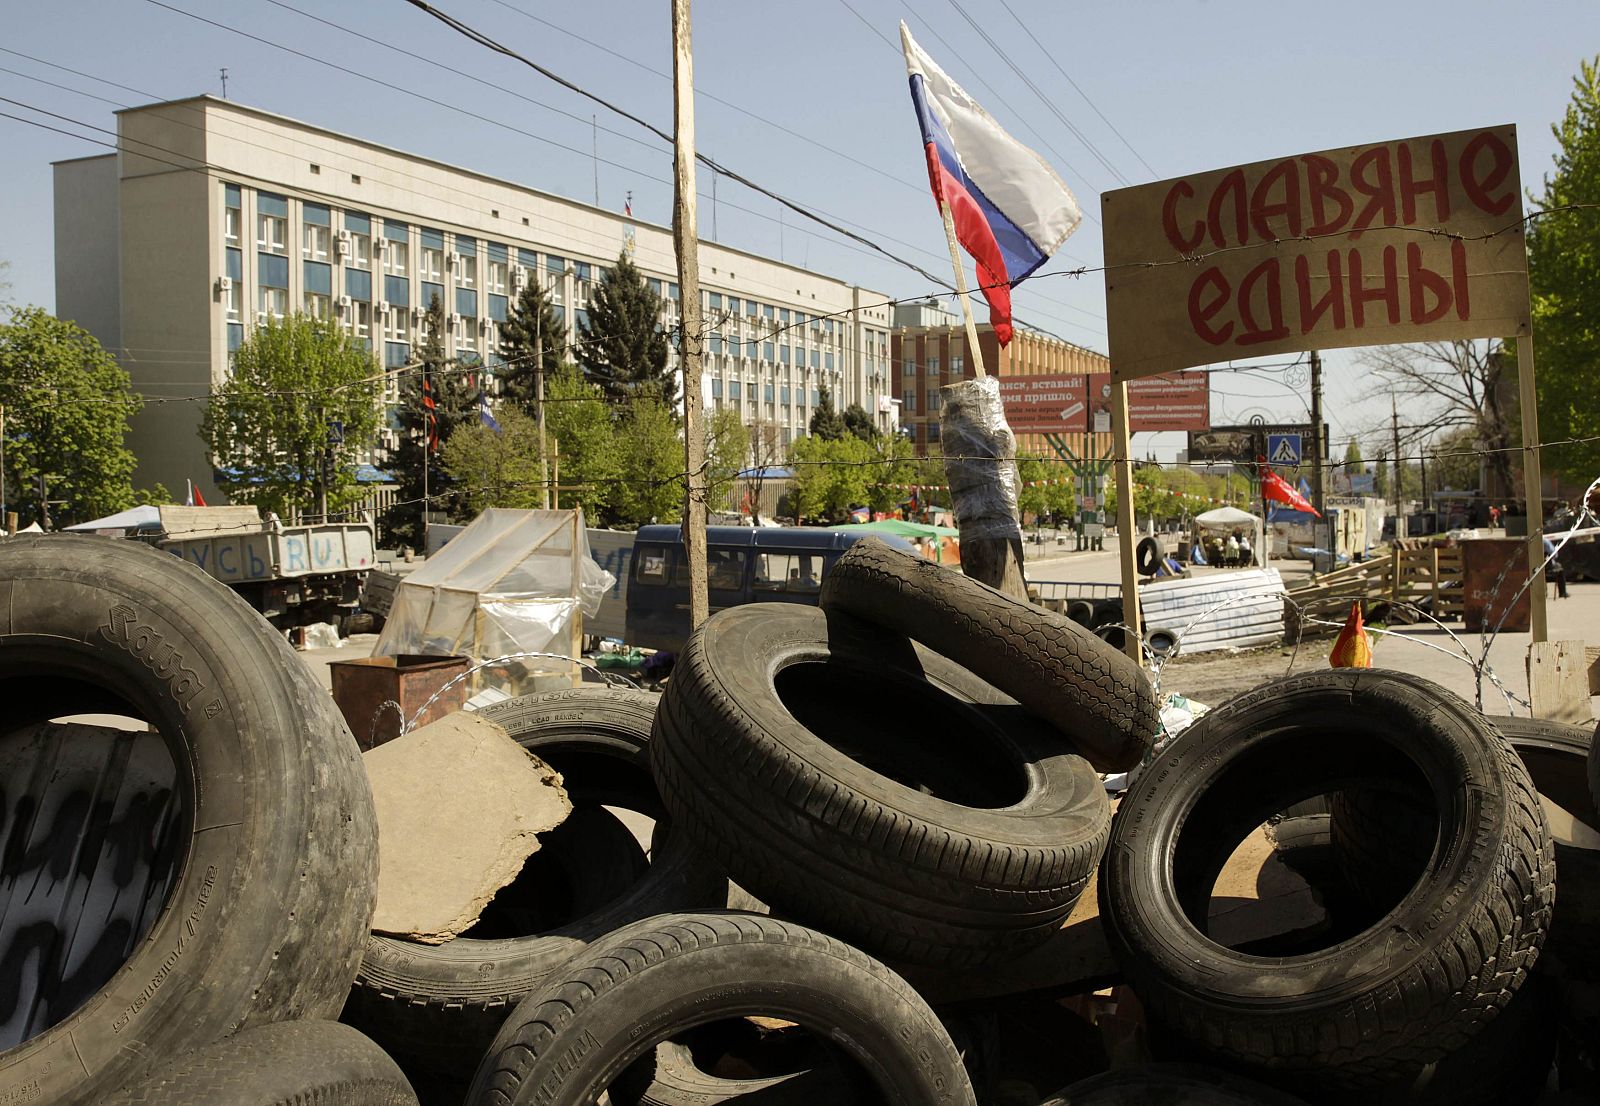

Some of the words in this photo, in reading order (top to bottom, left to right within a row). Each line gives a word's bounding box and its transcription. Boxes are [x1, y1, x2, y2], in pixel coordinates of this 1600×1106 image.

[999, 381, 1029, 391] анск,
[1032, 377, 1083, 389] вставай!
[1024, 392, 1076, 404] пришло.
[1328, 496, 1363, 505] ОССИЯ
[170, 544, 266, 578] УСЬ
